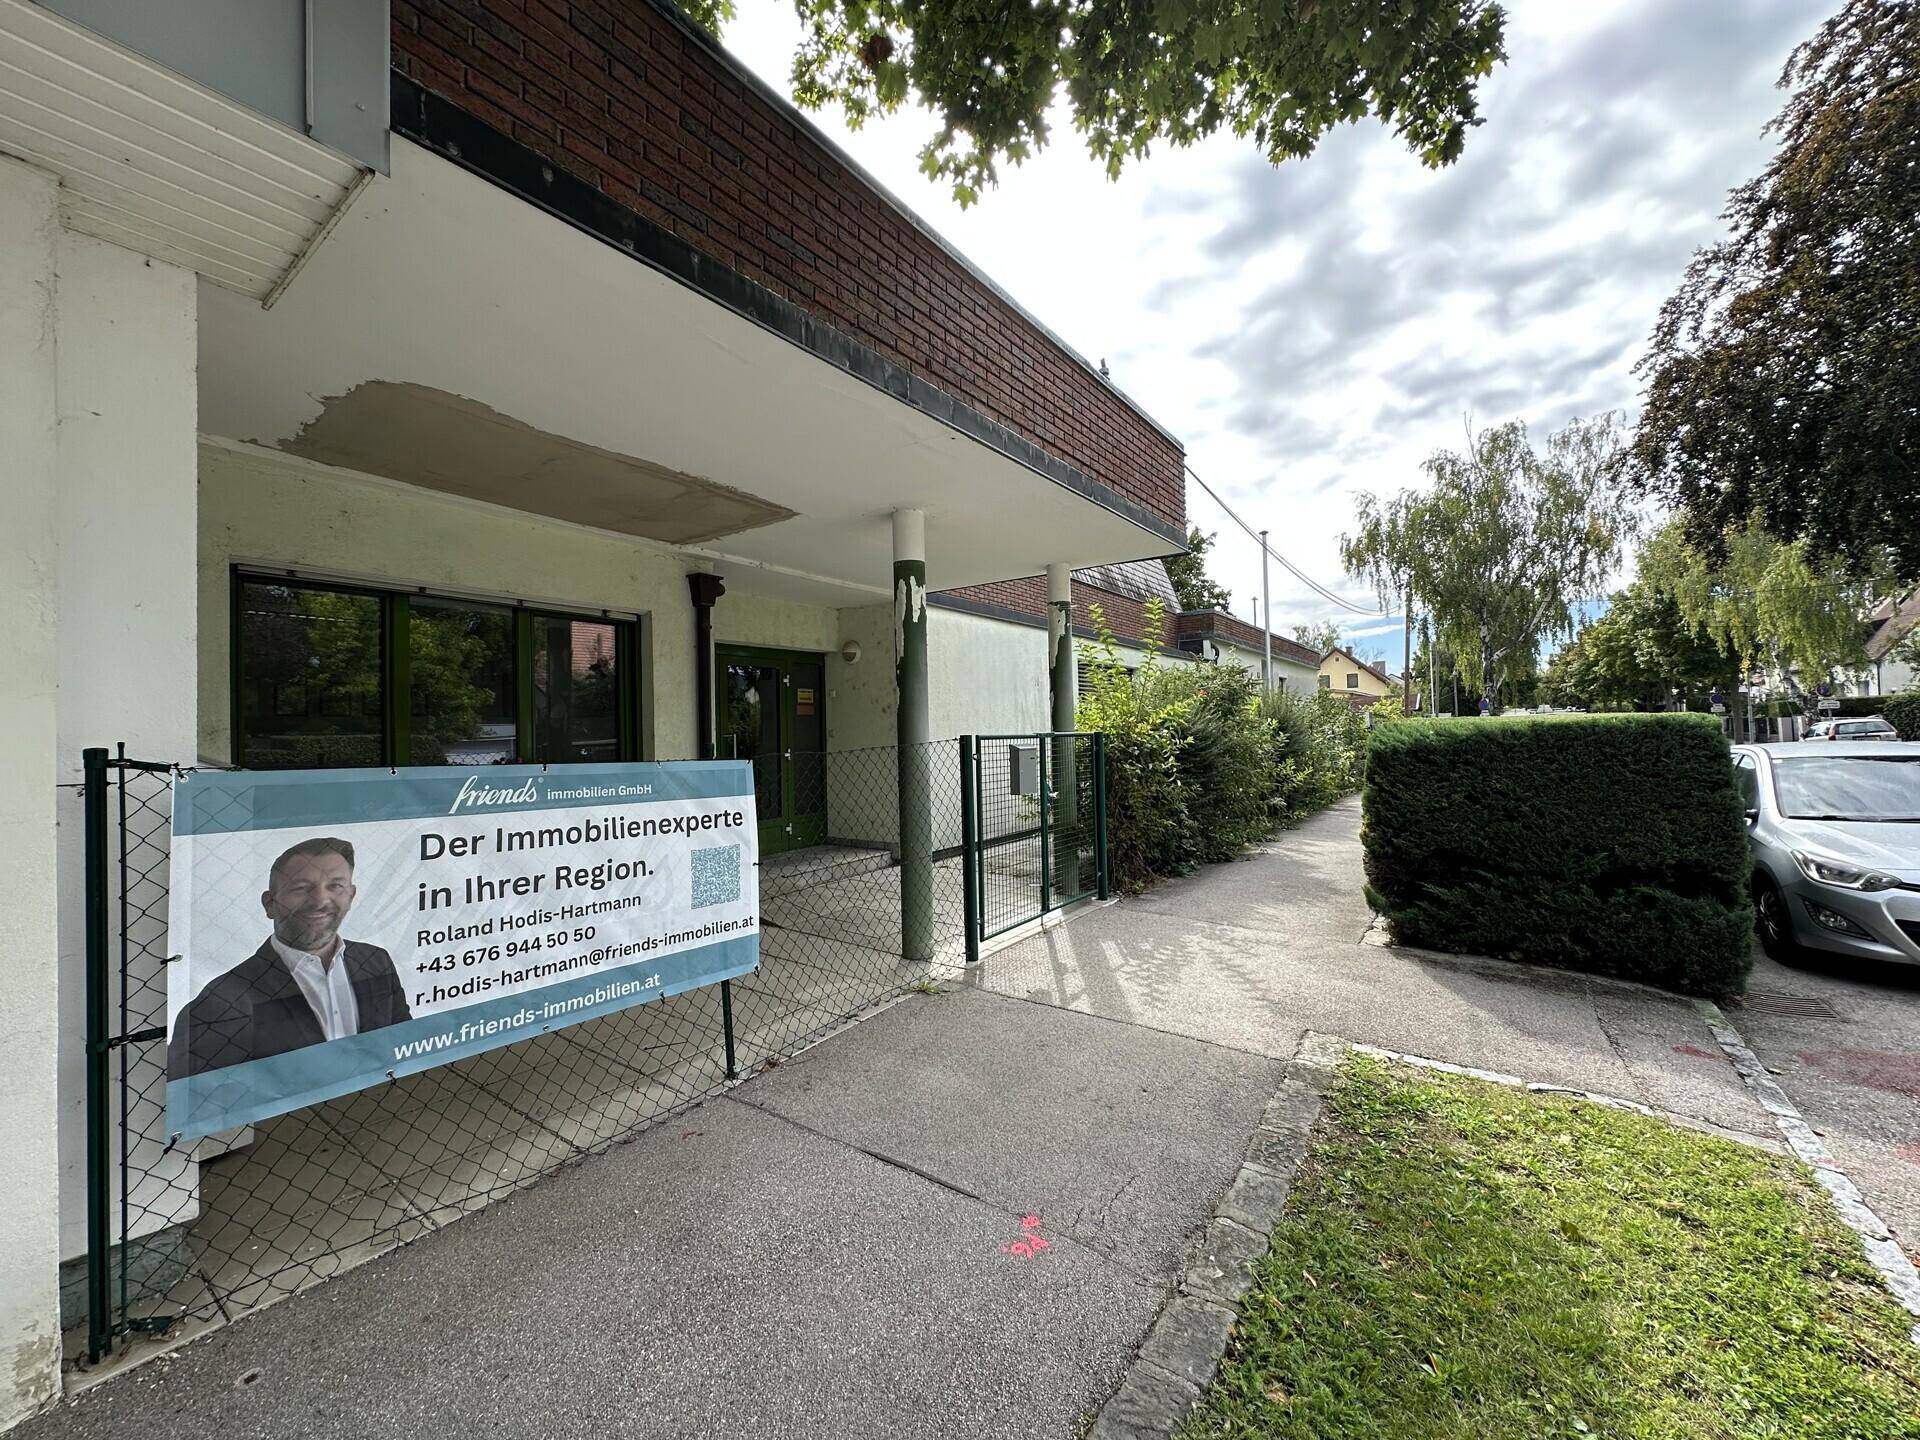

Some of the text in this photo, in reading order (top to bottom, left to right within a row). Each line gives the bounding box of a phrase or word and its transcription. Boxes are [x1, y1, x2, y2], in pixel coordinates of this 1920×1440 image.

[448, 775, 652, 815] friends immobilien GmbH
[420, 809, 743, 861] Der Immobilienexperte
[418, 858, 654, 911] in Ihrer Region.
[417, 895, 642, 947] Roland Hodis-Hartmann
[415, 926, 596, 973] +43 676 944 50 50
[415, 915, 754, 1006] r.hodis-hartmann@friends-immobilien.at
[393, 972, 661, 1060] www.friends-immobilien.at
